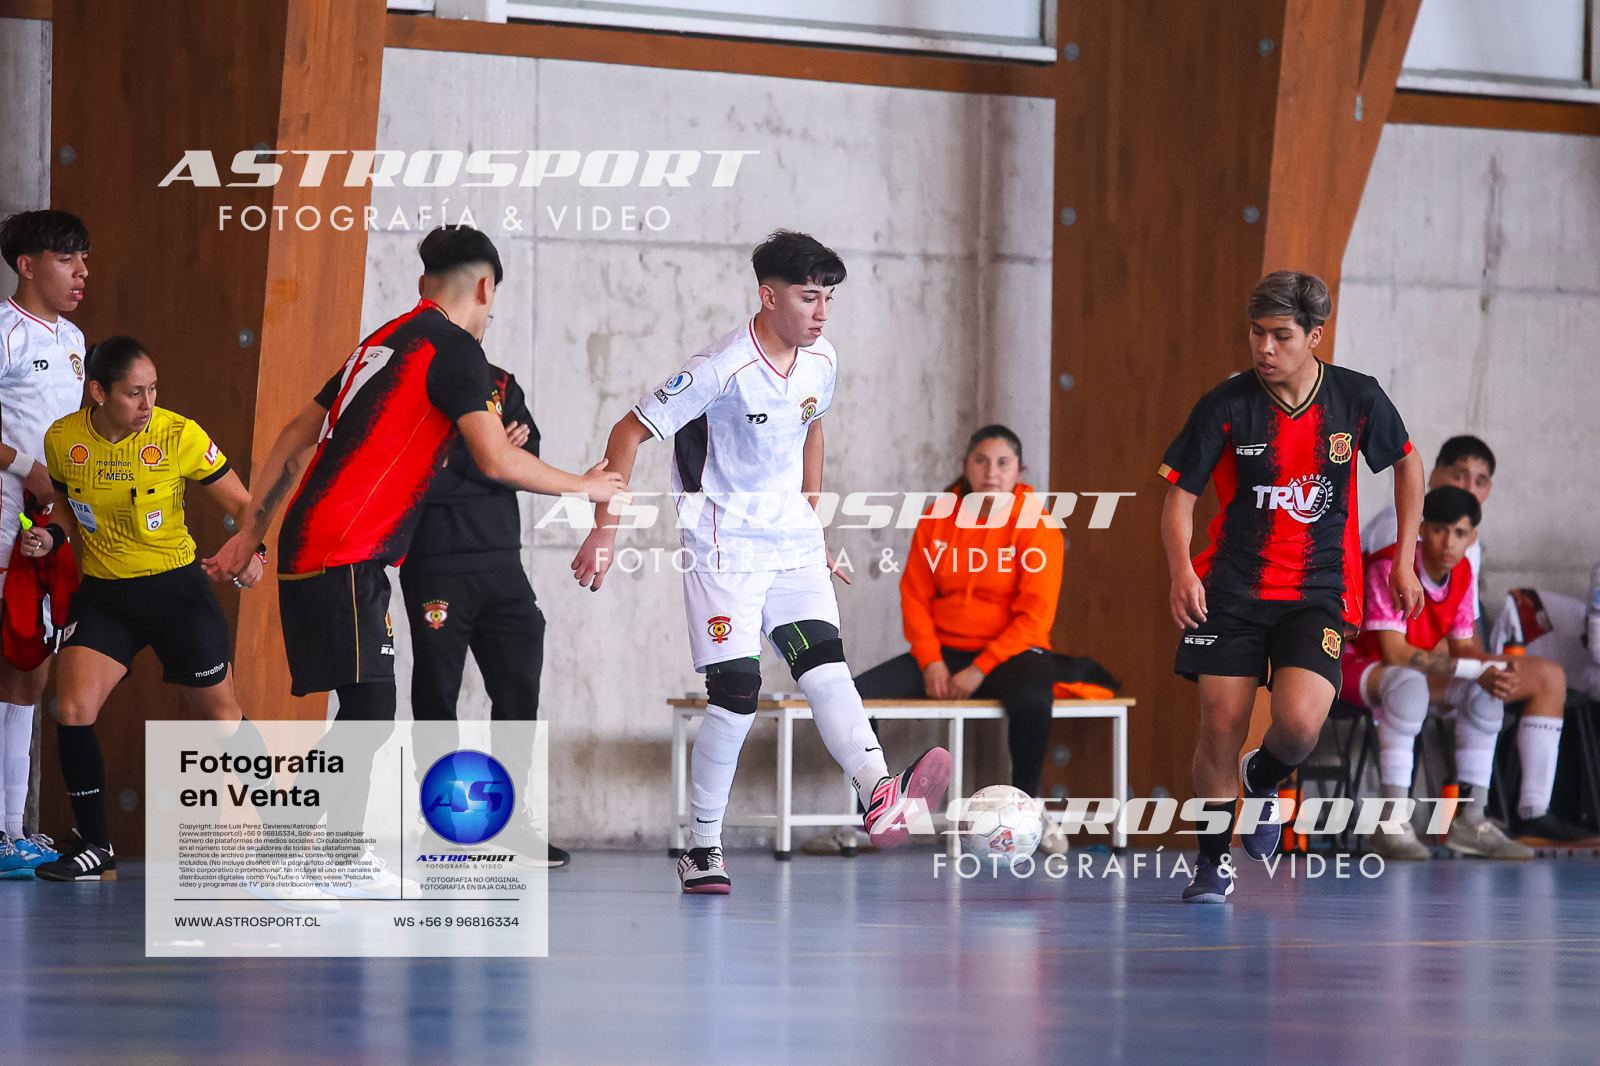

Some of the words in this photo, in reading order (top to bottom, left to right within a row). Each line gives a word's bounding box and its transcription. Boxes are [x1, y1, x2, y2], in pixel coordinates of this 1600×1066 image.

[106, 472, 135, 481] MEDS
[1252, 485, 1320, 511] TRV
[71, 500, 92, 514] FIFA
